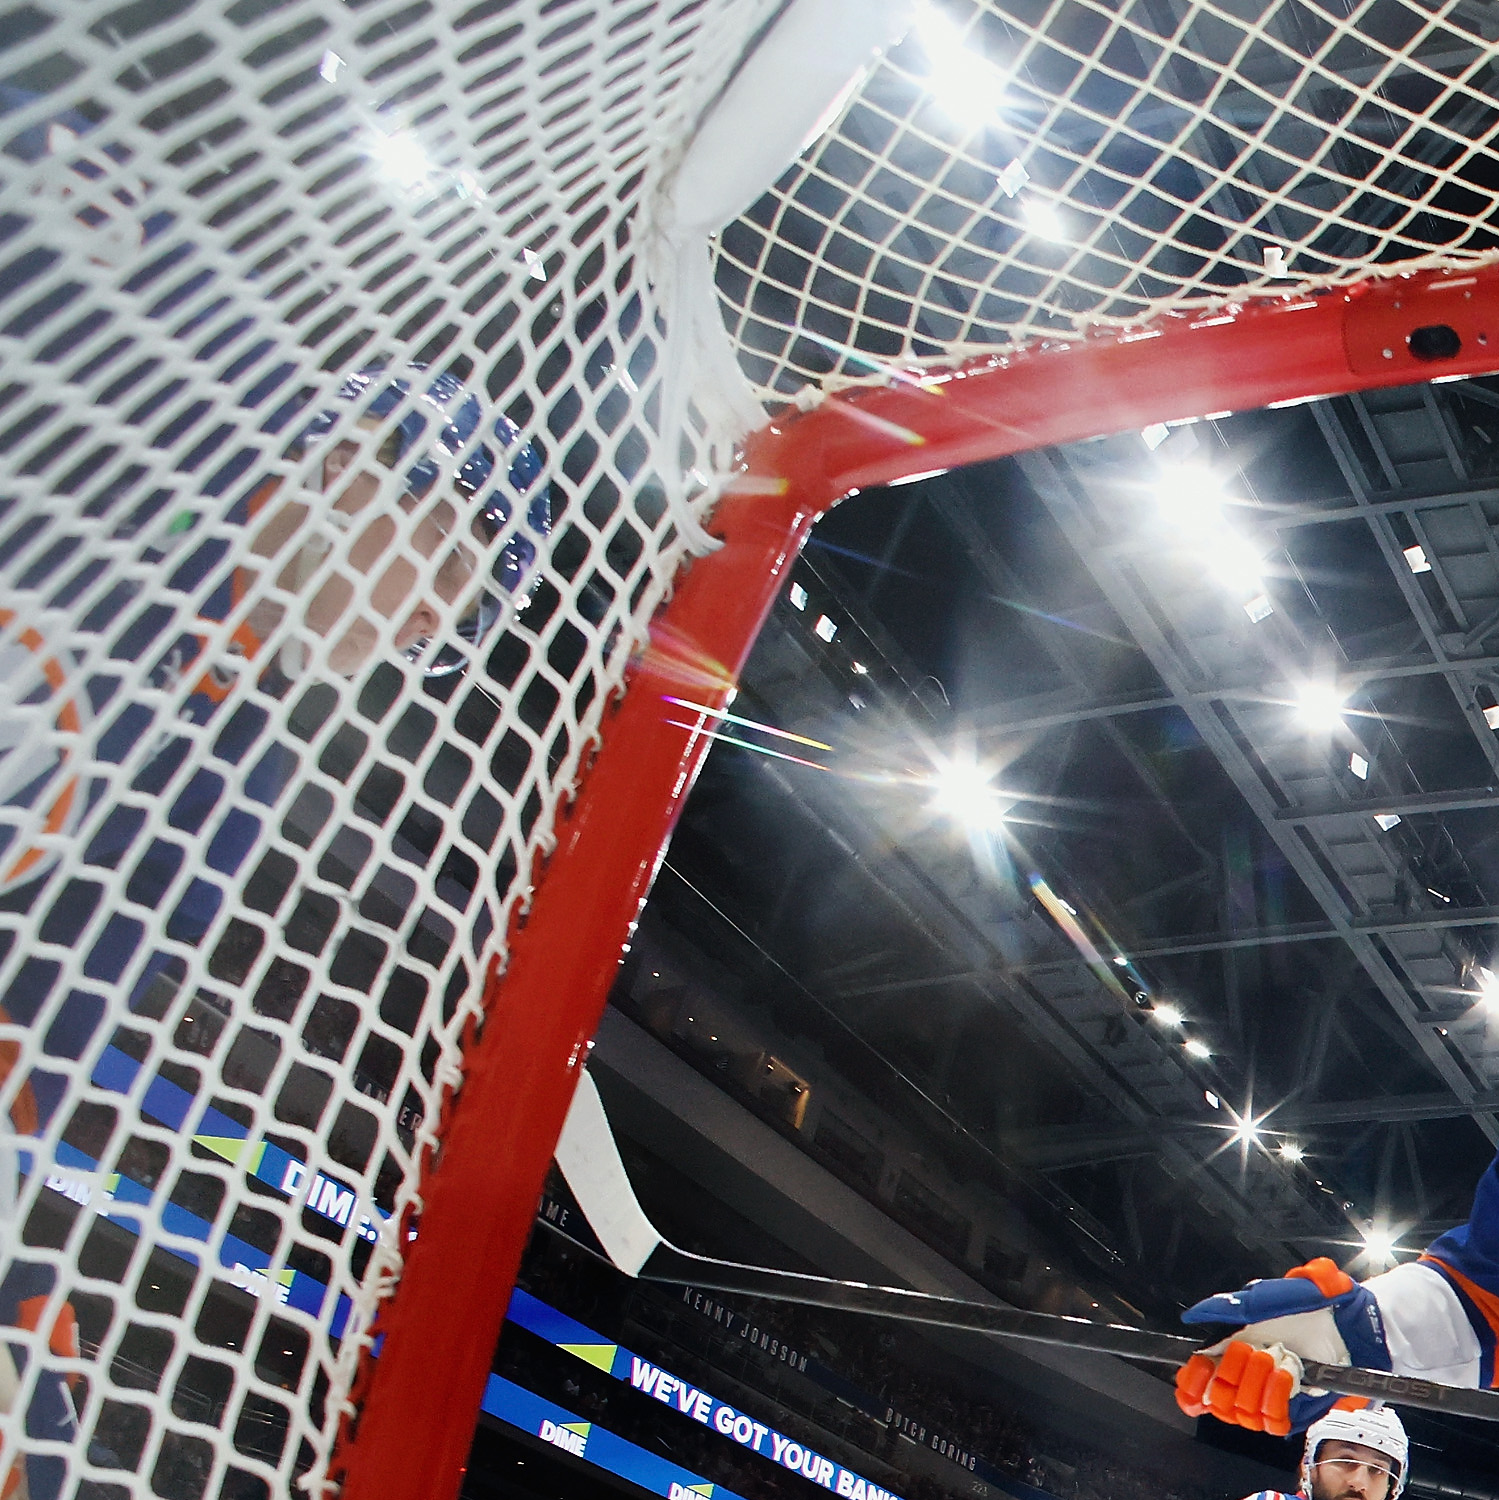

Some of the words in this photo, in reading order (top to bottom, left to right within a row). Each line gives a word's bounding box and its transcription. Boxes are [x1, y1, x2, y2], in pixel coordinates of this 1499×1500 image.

[683, 1286, 736, 1329] KENNY
[740, 1322, 808, 1374] JONSSON
[539, 1419, 588, 1459] DIME
[631, 1356, 710, 1423] WE'VE
[714, 1404, 768, 1454] GOT
[770, 1432, 836, 1489] YOUR
[885, 1406, 926, 1442] BUTCH
[931, 1434, 978, 1472] GORING
